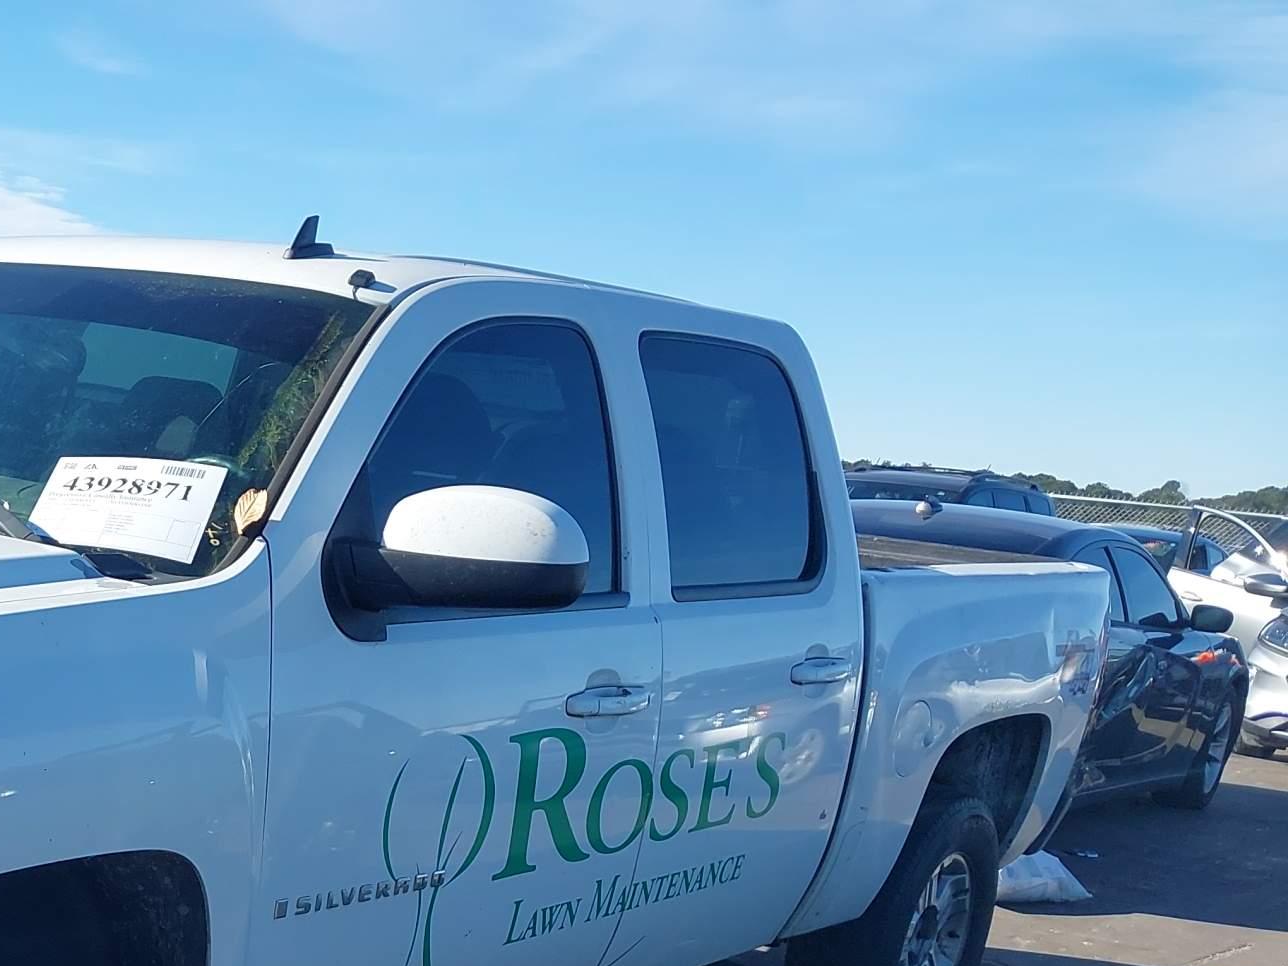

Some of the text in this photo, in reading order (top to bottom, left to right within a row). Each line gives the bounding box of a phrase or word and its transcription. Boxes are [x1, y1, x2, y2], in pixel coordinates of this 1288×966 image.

[62, 475, 194, 502] 43928971
[503, 854, 746, 945] LAWN MAINTENANCE
